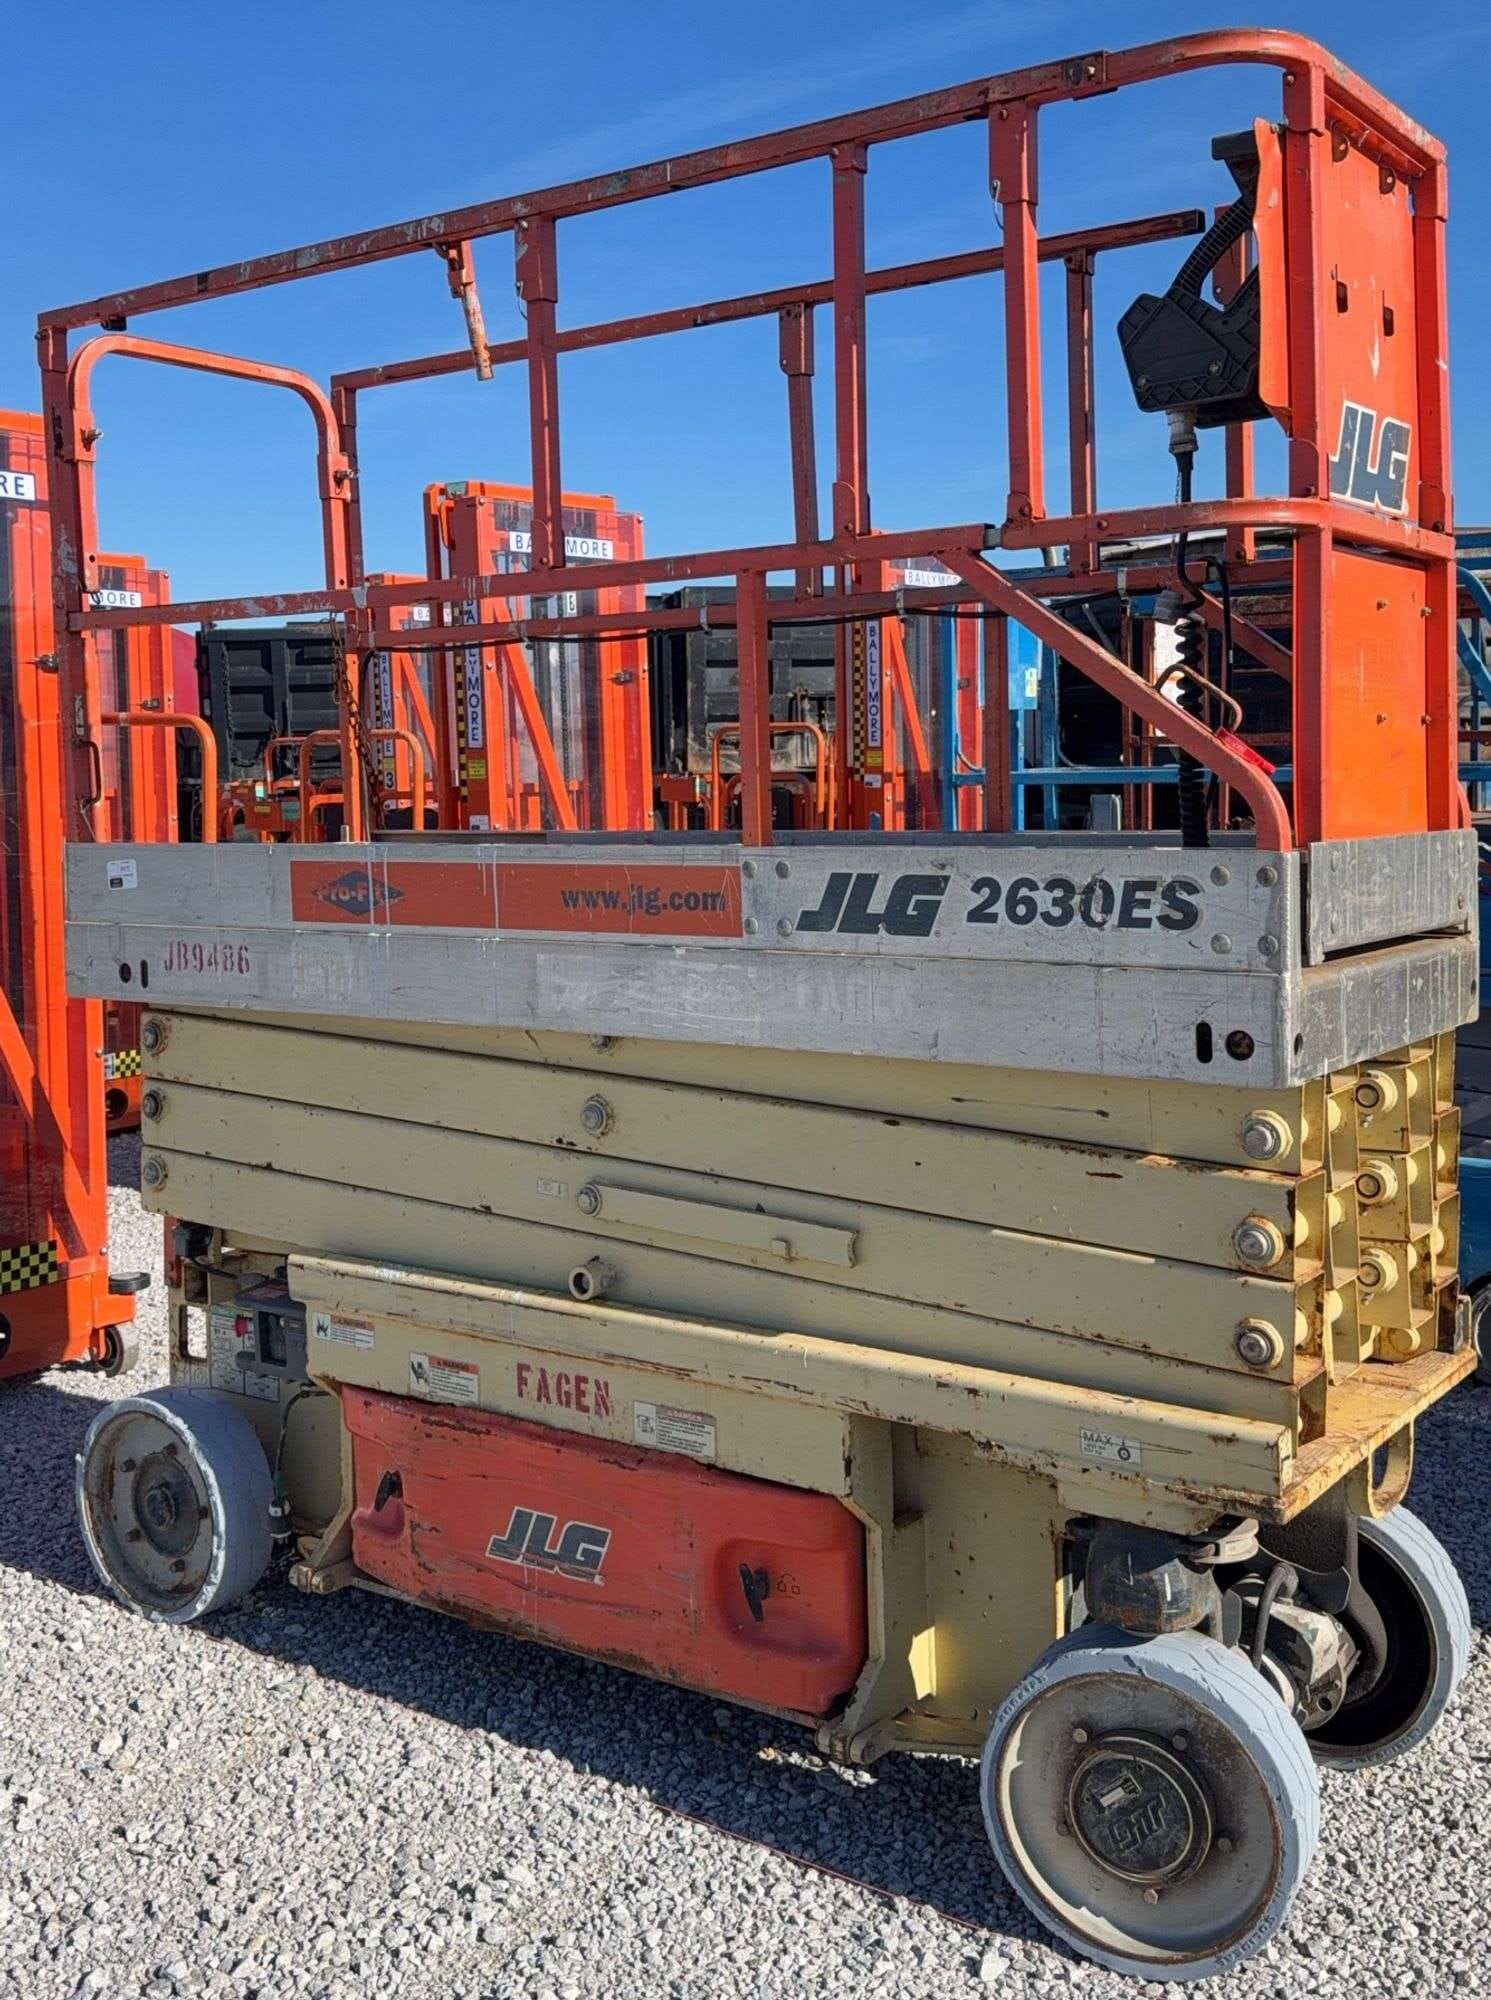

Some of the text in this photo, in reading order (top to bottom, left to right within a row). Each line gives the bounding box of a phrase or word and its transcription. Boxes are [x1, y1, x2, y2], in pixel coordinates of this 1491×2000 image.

[1330, 402, 1411, 514] JLG
[869, 625, 879, 743] BALLYMORE
[561, 885, 726, 916] www.jlg.com
[797, 872, 1201, 937] JLG 2630ES
[516, 1362, 614, 1417] FAGEN
[486, 1506, 611, 1584] JLG
